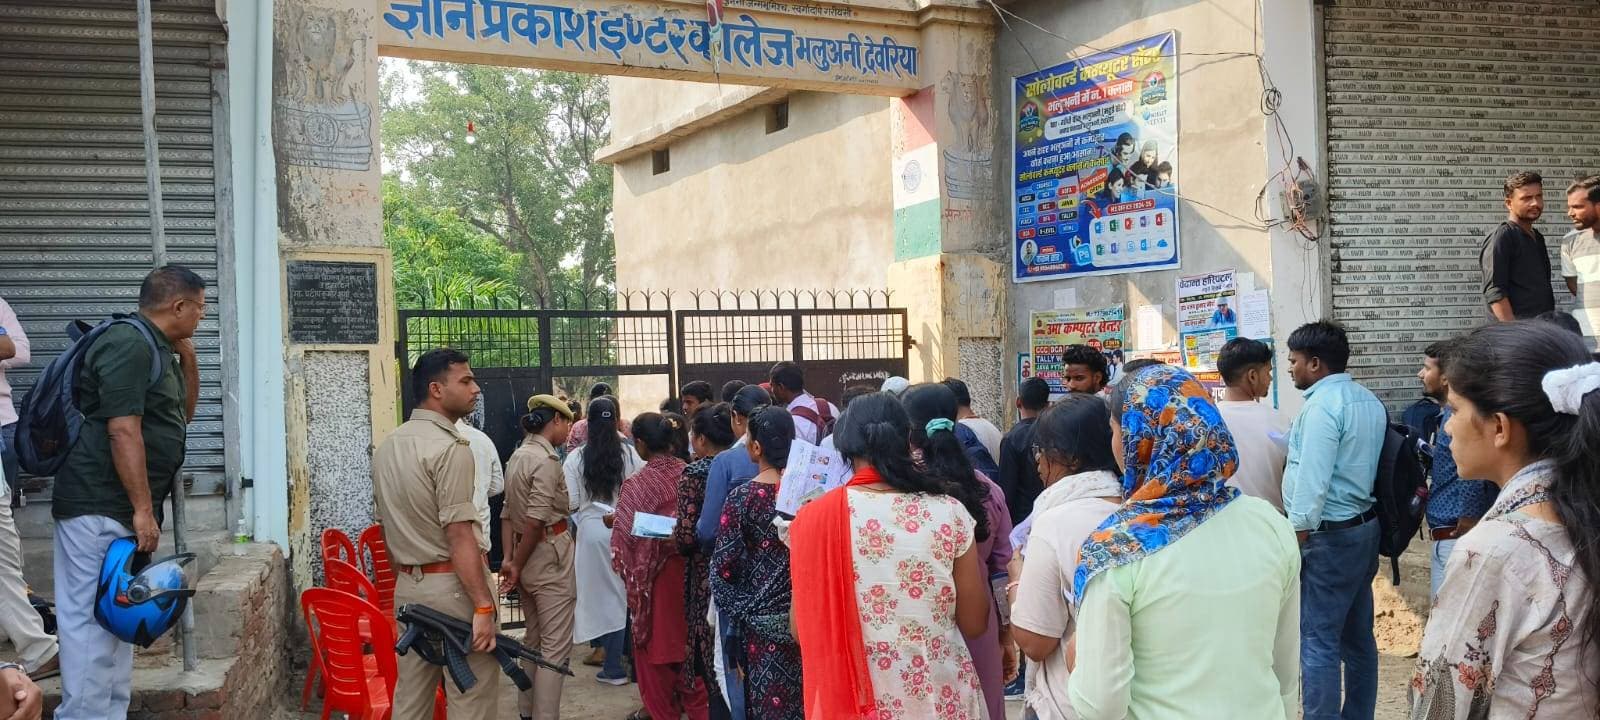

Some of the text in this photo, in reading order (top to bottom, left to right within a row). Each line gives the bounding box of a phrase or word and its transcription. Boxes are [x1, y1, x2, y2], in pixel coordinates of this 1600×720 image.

[480, 0, 597, 52] प्रकाश
[1047, 322, 1061, 335] उमा
[1036, 346, 1048, 354] CCC
[1036, 355, 1055, 363] TALLY
